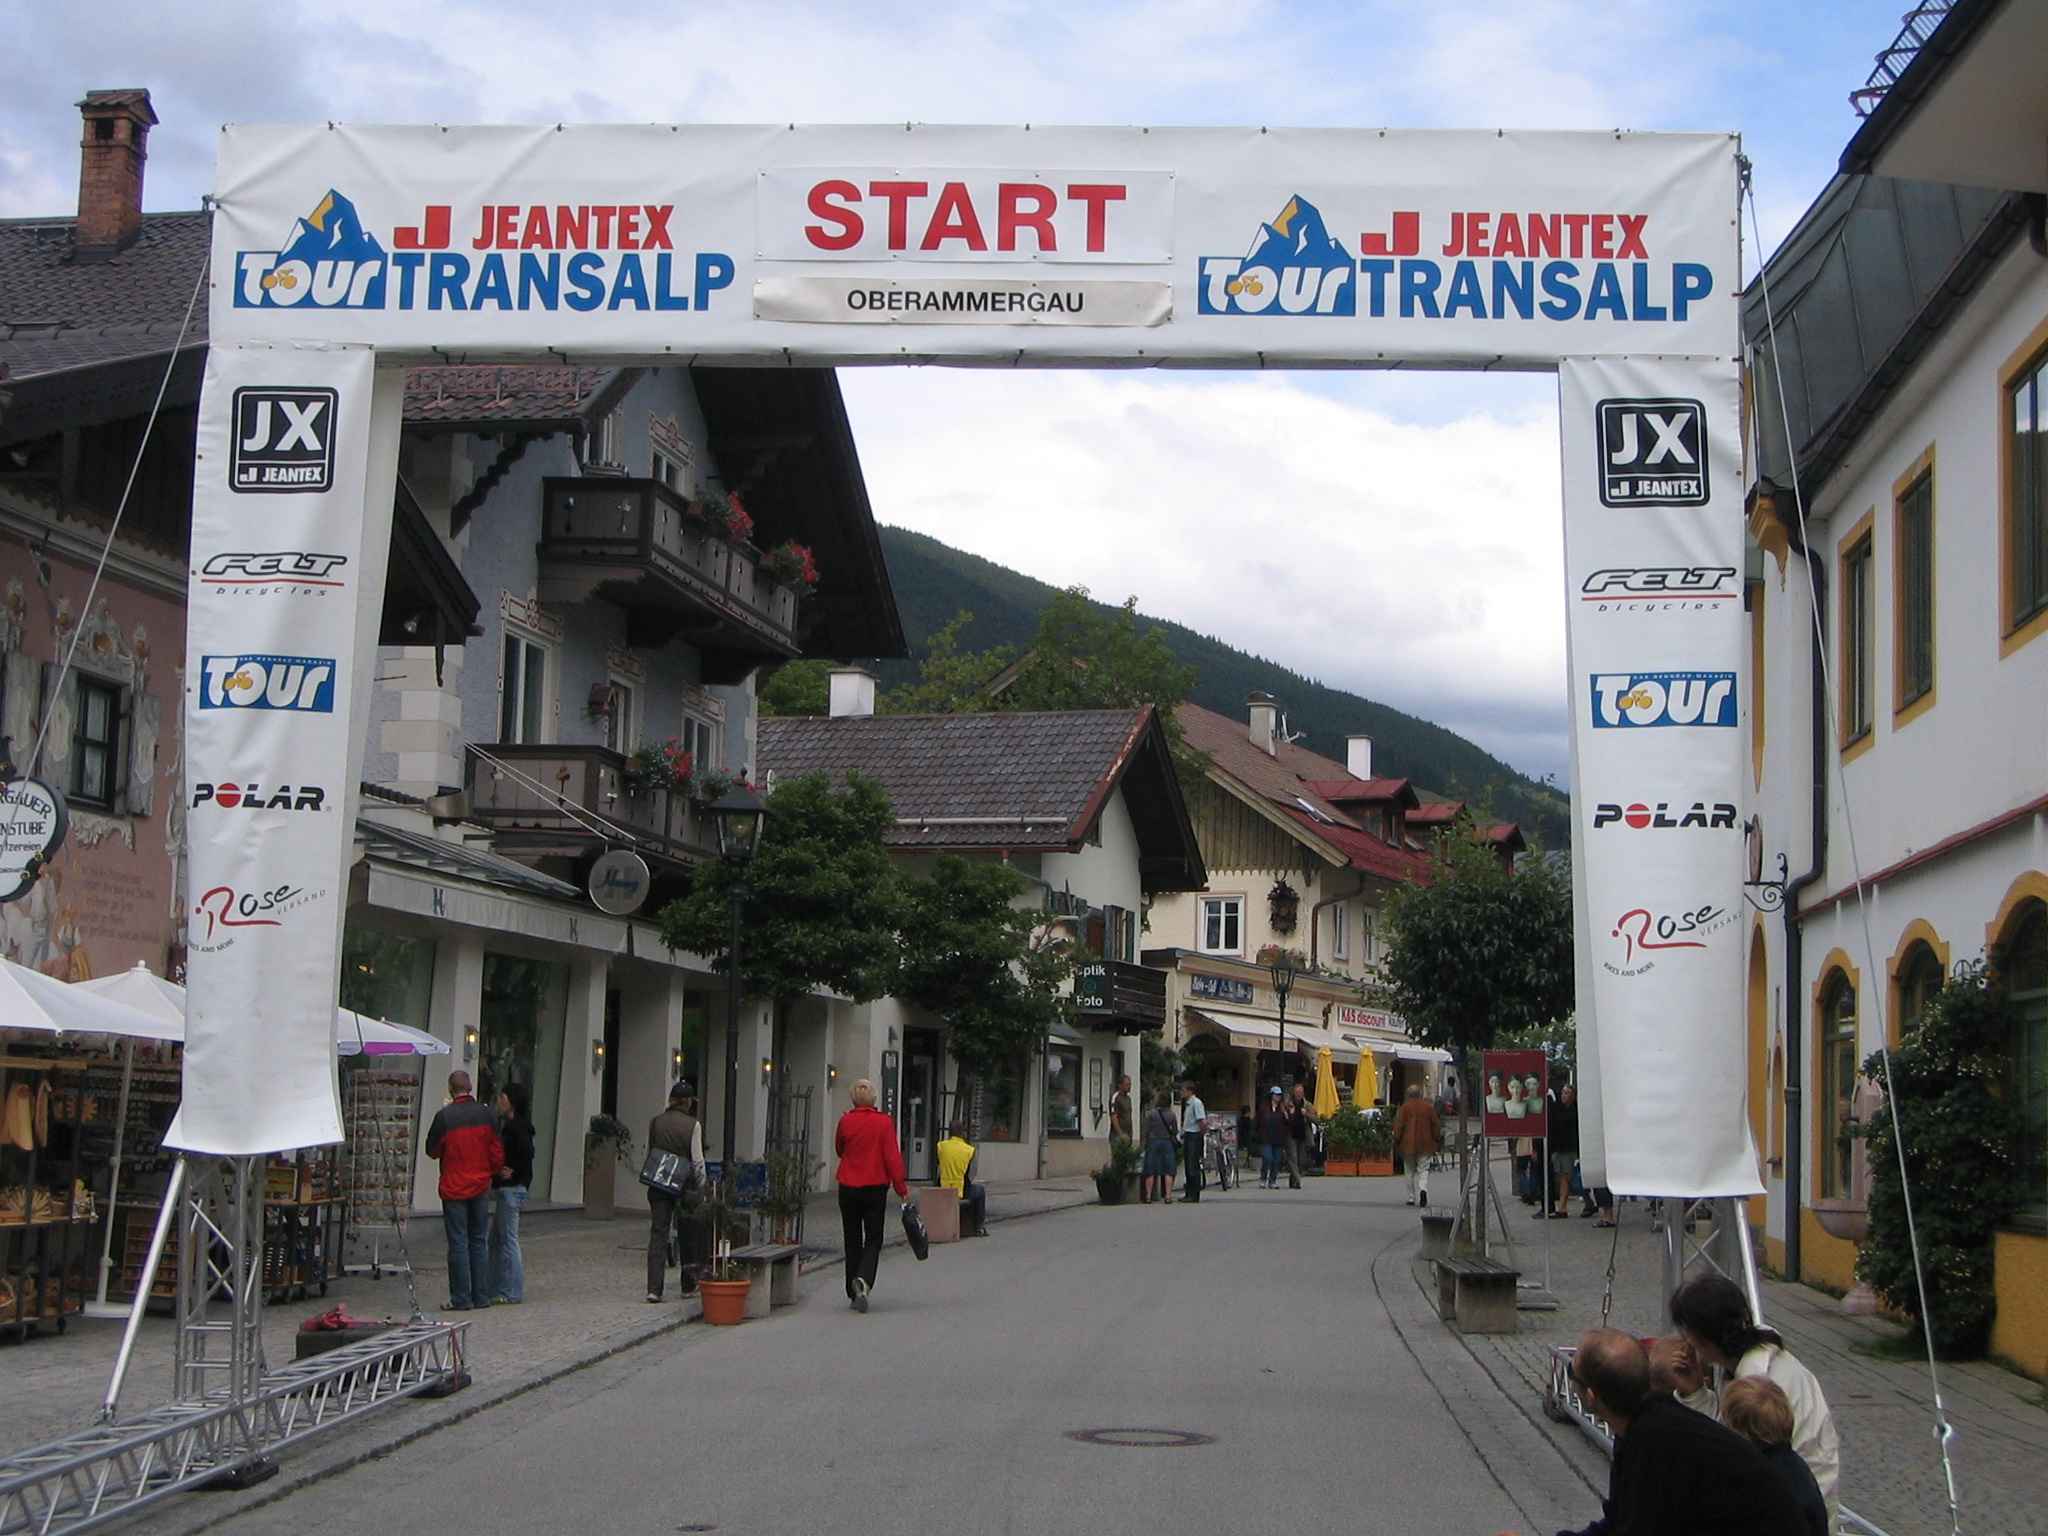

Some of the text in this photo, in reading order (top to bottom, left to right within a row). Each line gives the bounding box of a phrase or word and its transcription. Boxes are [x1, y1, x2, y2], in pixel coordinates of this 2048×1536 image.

[472, 205, 675, 250] JEANTEX
[804, 180, 1127, 252] START
[1442, 212, 1649, 259] JEANTEX
[389, 252, 735, 312] TRANSALP
[1361, 259, 1714, 322] TRANSALP
[847, 289, 1084, 313] OBERAMMERGAU
[243, 400, 327, 452] JX
[1611, 412, 1696, 465] JX
[262, 466, 323, 483] JEANTEX
[1635, 480, 1701, 497] JEANTEX
[202, 552, 348, 577] FELT
[216, 586, 328, 598] bicycles
[1582, 567, 1737, 592] FELT
[1598, 602, 1721, 613] bicycles
[191, 782, 326, 812] POLAR
[1593, 803, 1737, 829] POLAR
[1078, 965, 1106, 978] ptik
